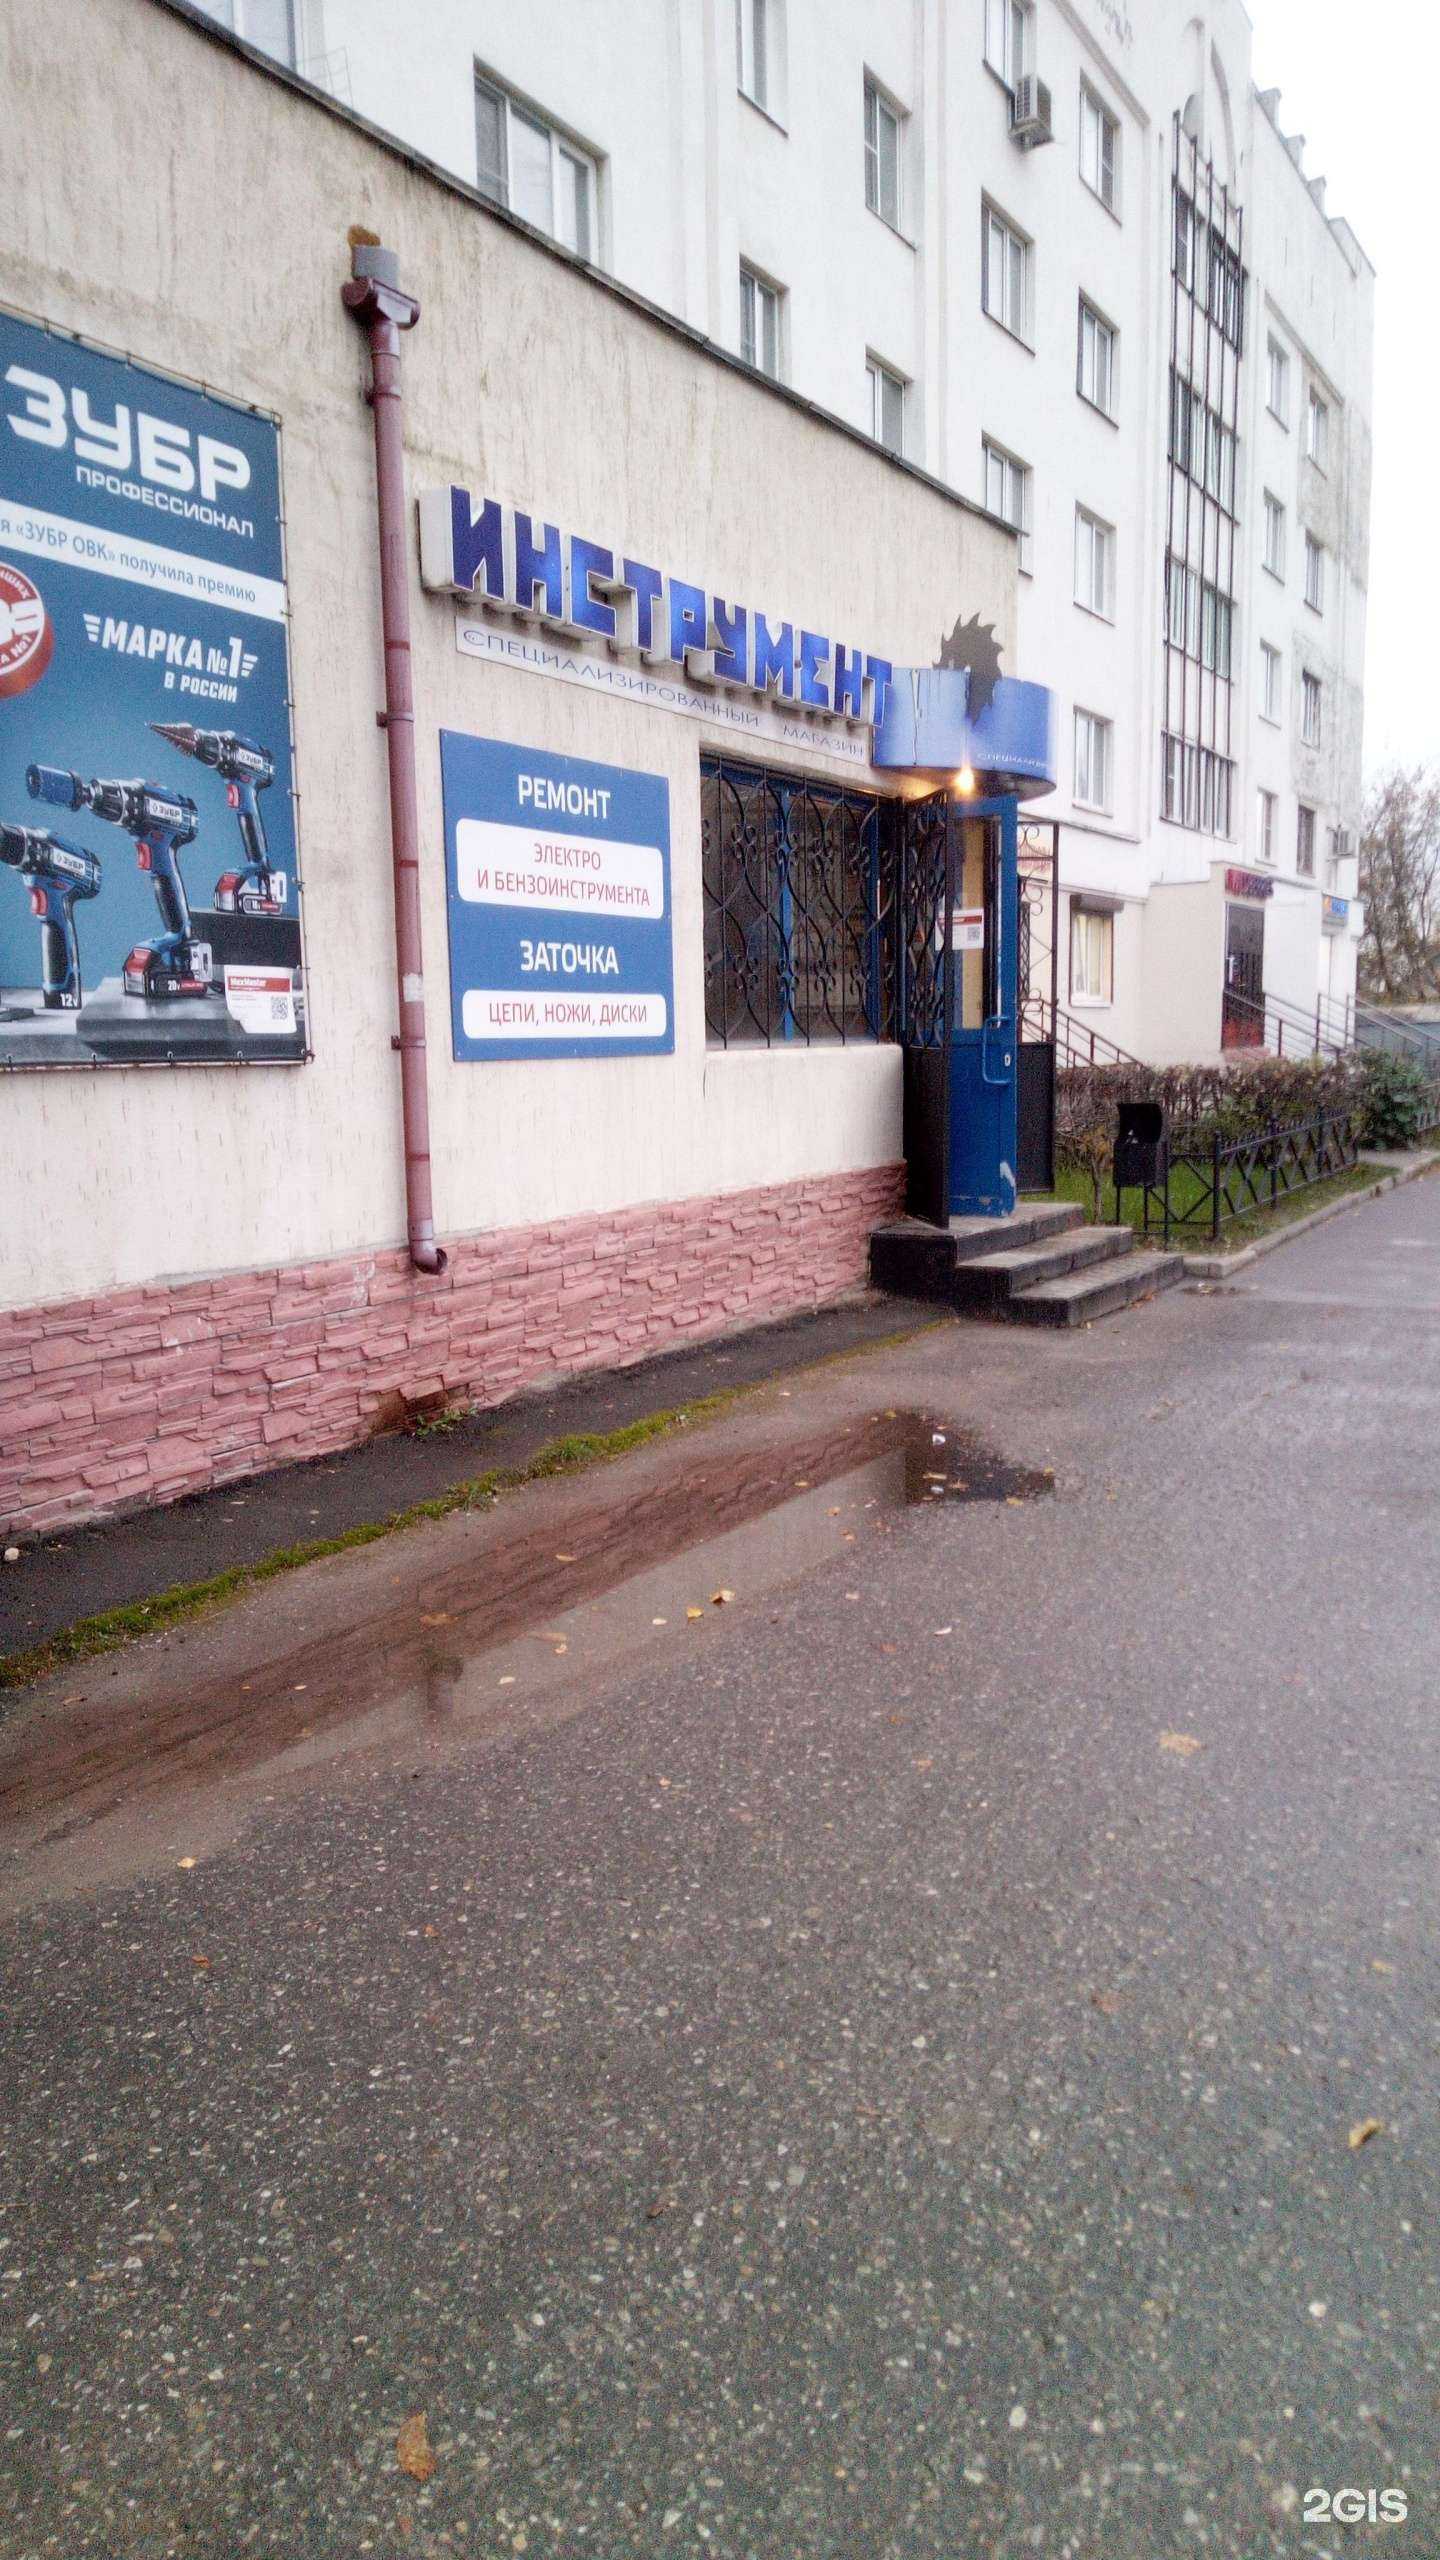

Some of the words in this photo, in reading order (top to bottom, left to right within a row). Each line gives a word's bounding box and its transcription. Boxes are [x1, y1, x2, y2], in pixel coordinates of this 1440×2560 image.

[5, 364, 251, 502] ЗУБР
[75, 465, 255, 539] ПРОФЕССИОНАЛ
[120, 549, 195, 588] получила
[199, 574, 257, 604] премию
[450, 484, 893, 728] ИНСТРУМЕНТ
[102, 615, 206, 671] МАРКА
[207, 635, 243, 679] №1
[164, 671, 175, 689] В
[180, 676, 238, 704] РОССИИ
[462, 629, 760, 728] СПЕЦИАЛИЗИРОВАННЫЙ
[784, 724, 865, 760] МАГАЗИН
[517, 774, 612, 819] РЕМОНТ
[533, 843, 602, 870] ЭЛЕКТРО
[477, 869, 490, 890] И
[494, 871, 651, 906] БЕНЗОИНСТРУМЕНТА
[519, 939, 620, 975] ЗАТОЧКА
[488, 1002, 540, 1027] ЦЕПИ,
[544, 1003, 596, 1027] НОЖИ,
[600, 1003, 648, 1025] ДИСКИ
